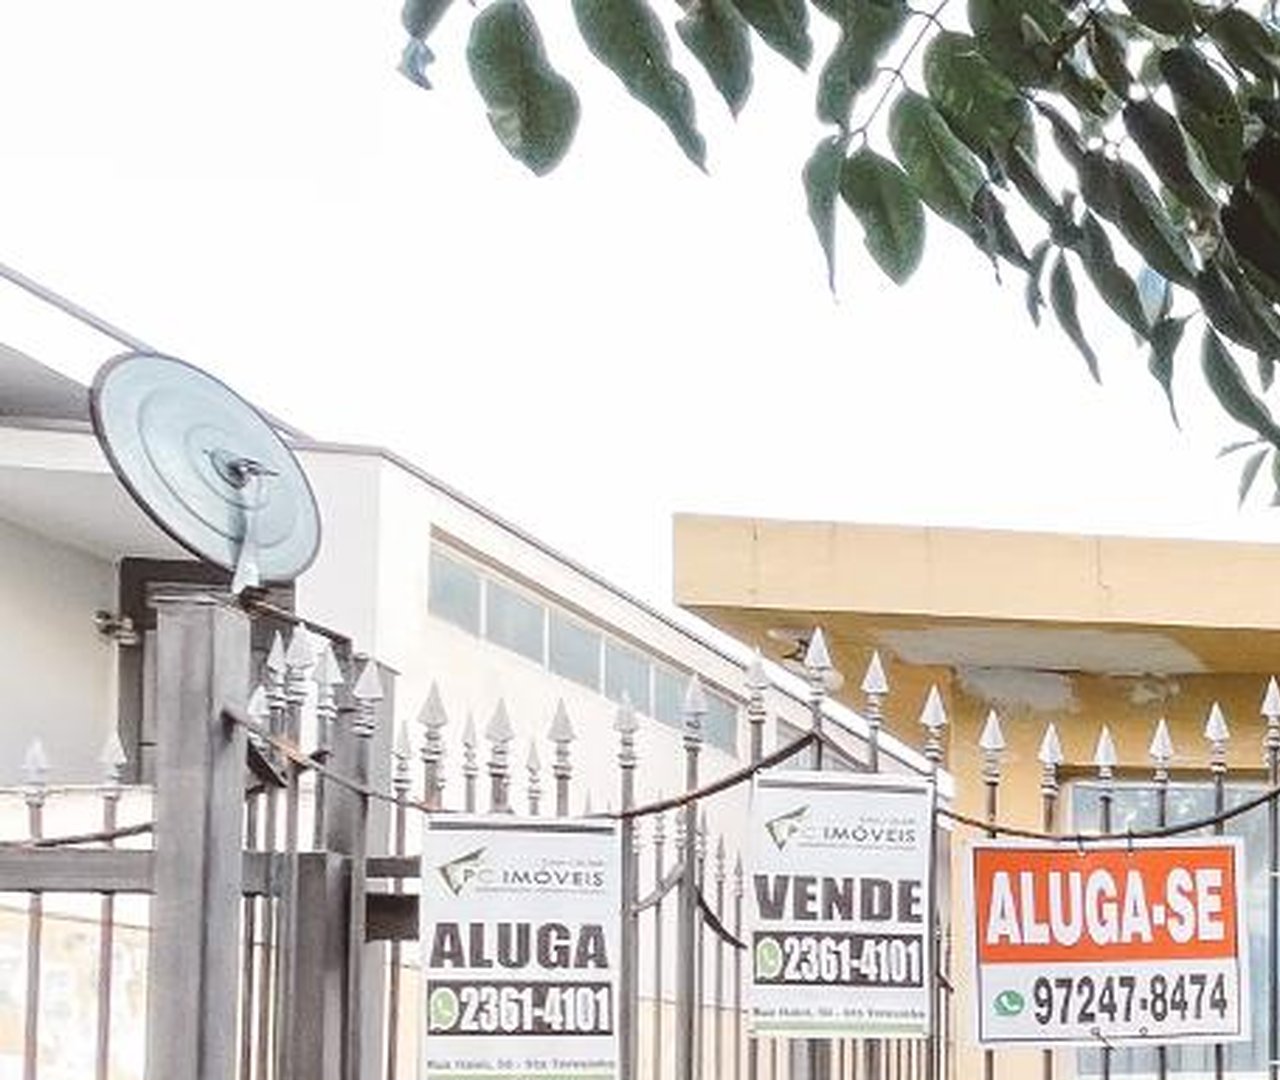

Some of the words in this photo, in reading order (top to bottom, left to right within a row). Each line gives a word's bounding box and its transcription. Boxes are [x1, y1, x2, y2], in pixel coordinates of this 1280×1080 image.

[823, 825, 917, 842] IMÓVEIS
[502, 867, 605, 887] IMÓVEIS
[753, 874, 923, 923] VENDE
[985, 867, 1226, 946] ALUGA-SE
[429, 922, 609, 970] ALUGA
[783, 935, 921, 984] 2361-4101
[459, 986, 609, 1032] 2361-4101
[1032, 972, 1228, 1025] 97247-8474
